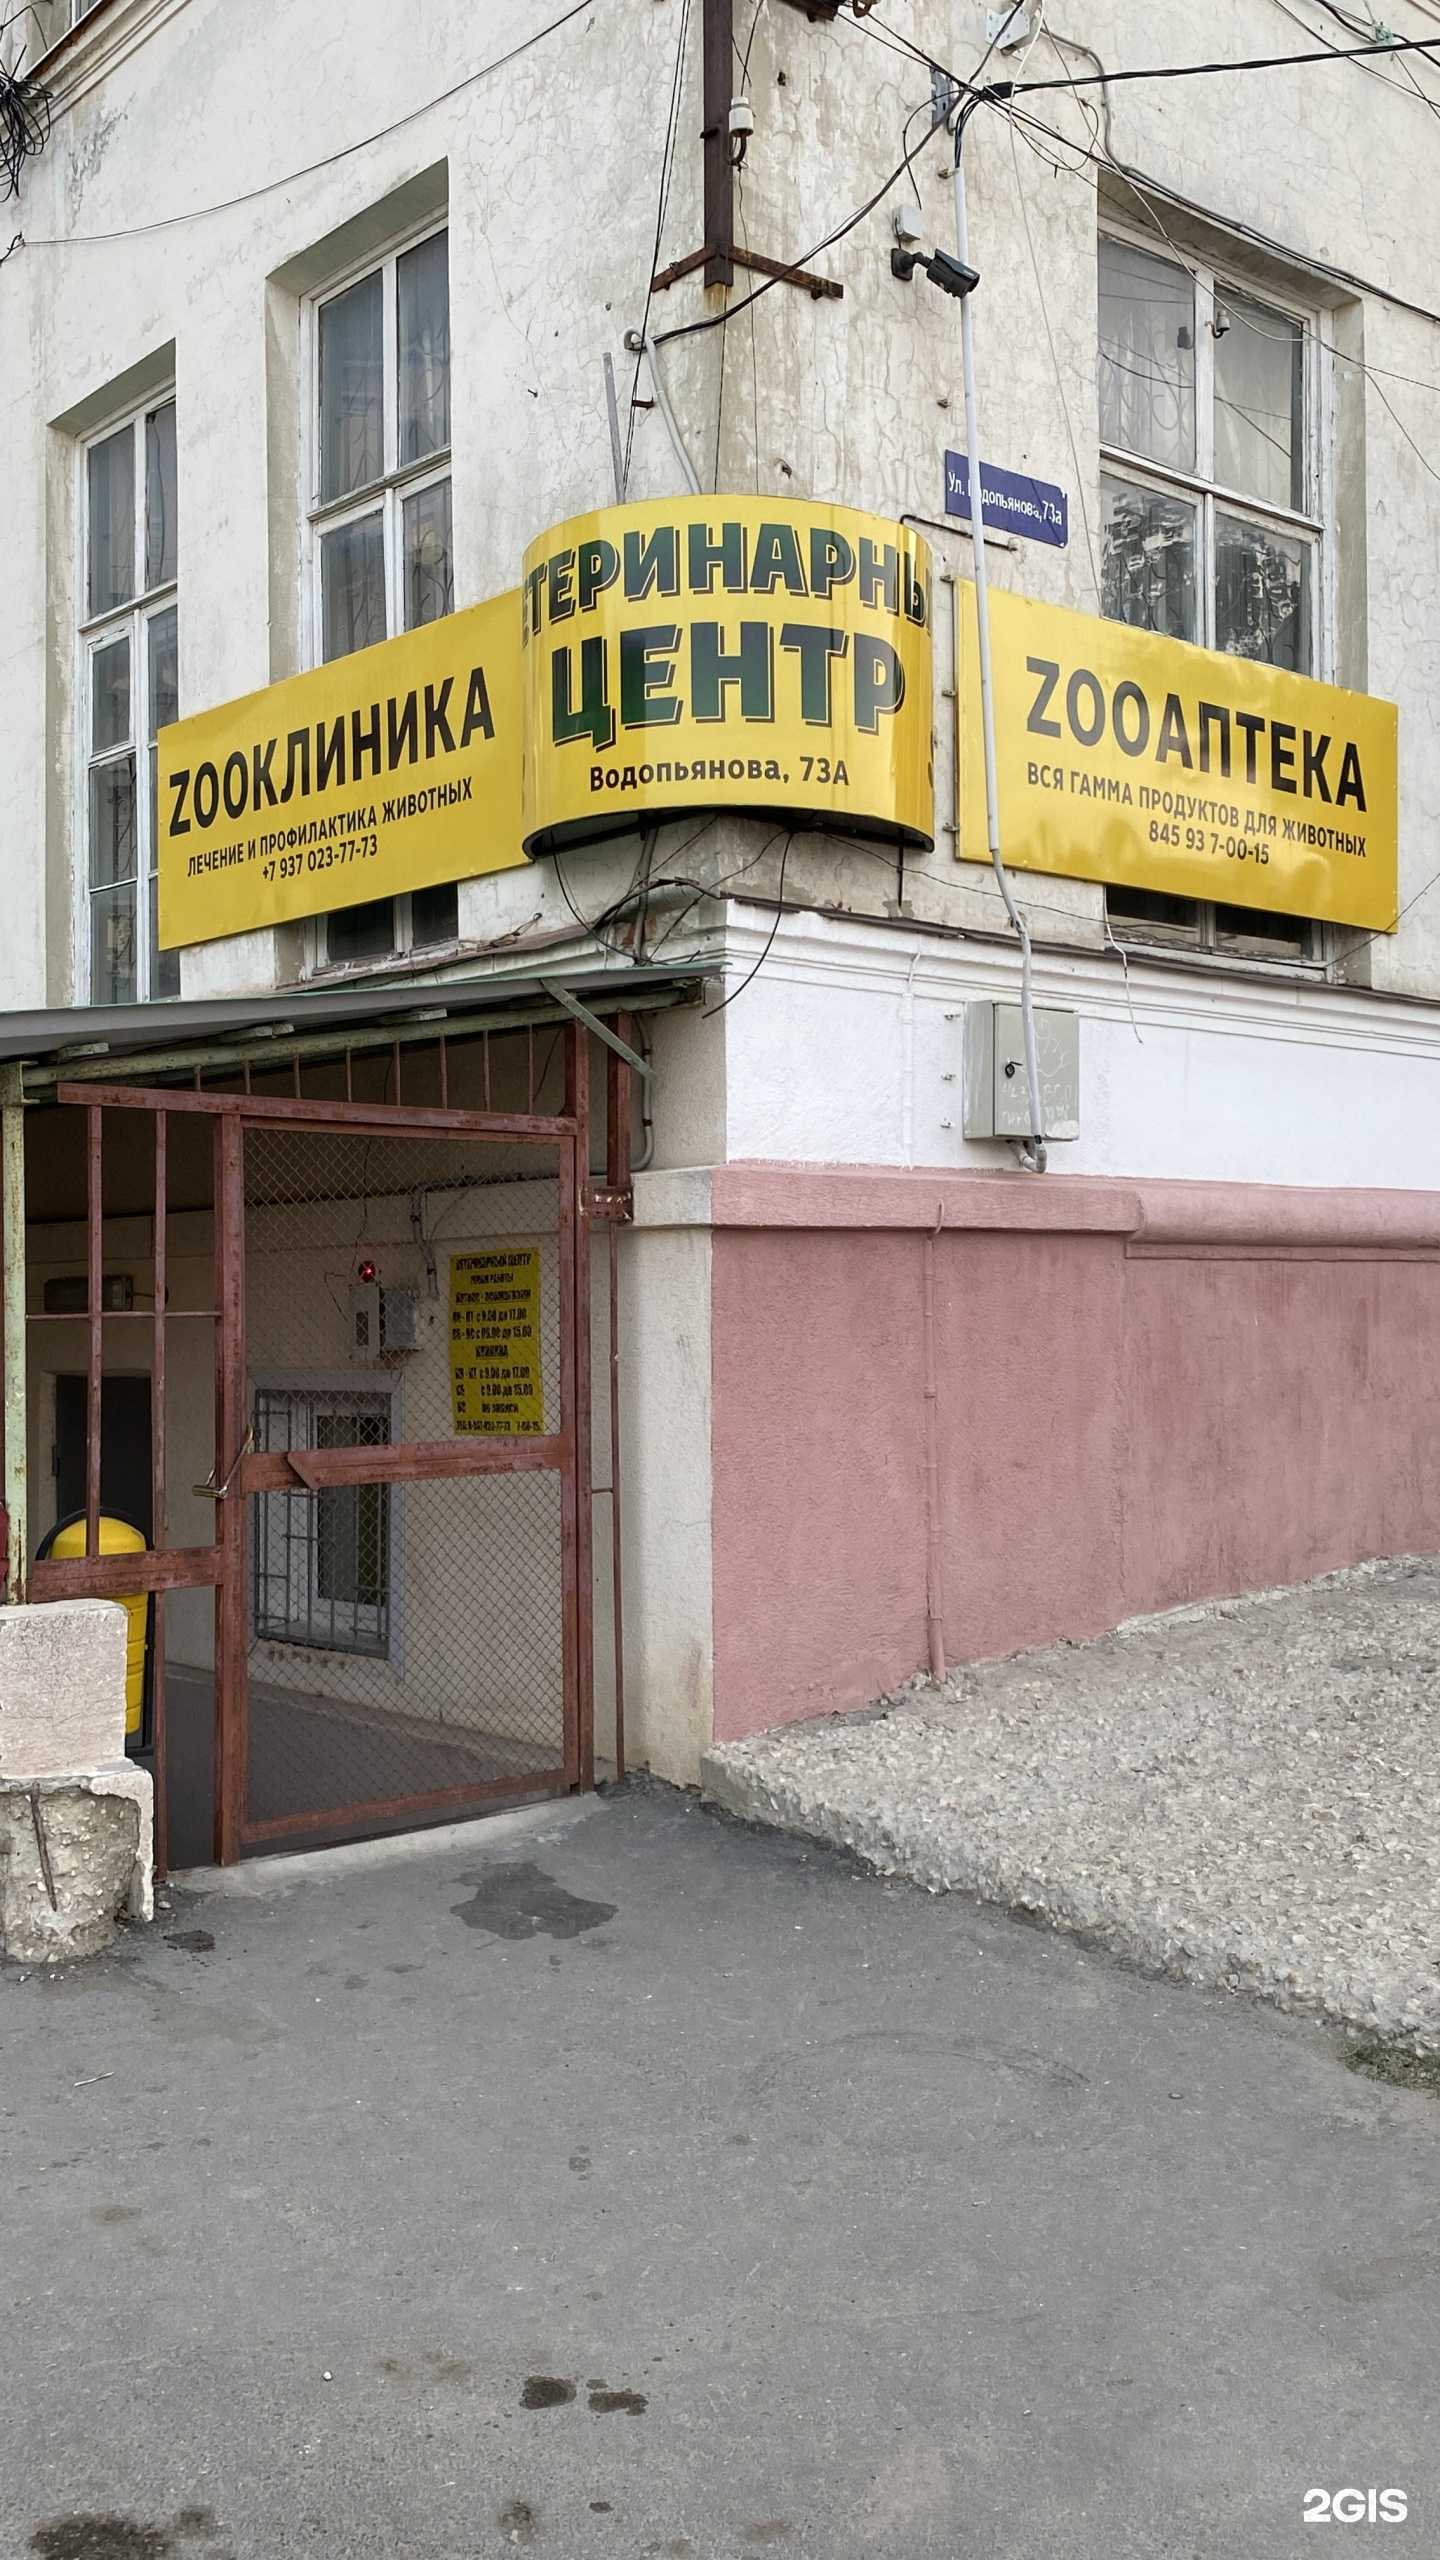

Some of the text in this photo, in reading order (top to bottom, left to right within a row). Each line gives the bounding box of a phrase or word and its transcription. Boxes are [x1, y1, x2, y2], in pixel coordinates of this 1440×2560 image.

[948, 471, 965, 496] Ул.
[552, 621, 906, 753] ЦЕНТР
[1026, 656, 1368, 813] ZOOАПТЕКА
[169, 666, 496, 837] ZOOКЛИНИКА
[590, 757, 850, 792] Водопьянова, 73А
[187, 776, 473, 878] ЛЕЧЕНИЕ И ПРОФИЛАКТИКА ЖИВОТНЫХ
[1027, 762, 1367, 857] ВСЯ ГАММА ПРОДУКТОВ ДЛЯ ЖИВОТНЫХ
[1148, 820, 1270, 865] 845 93 7-00-15
[262, 834, 378, 882] +7 937 023-77-73
